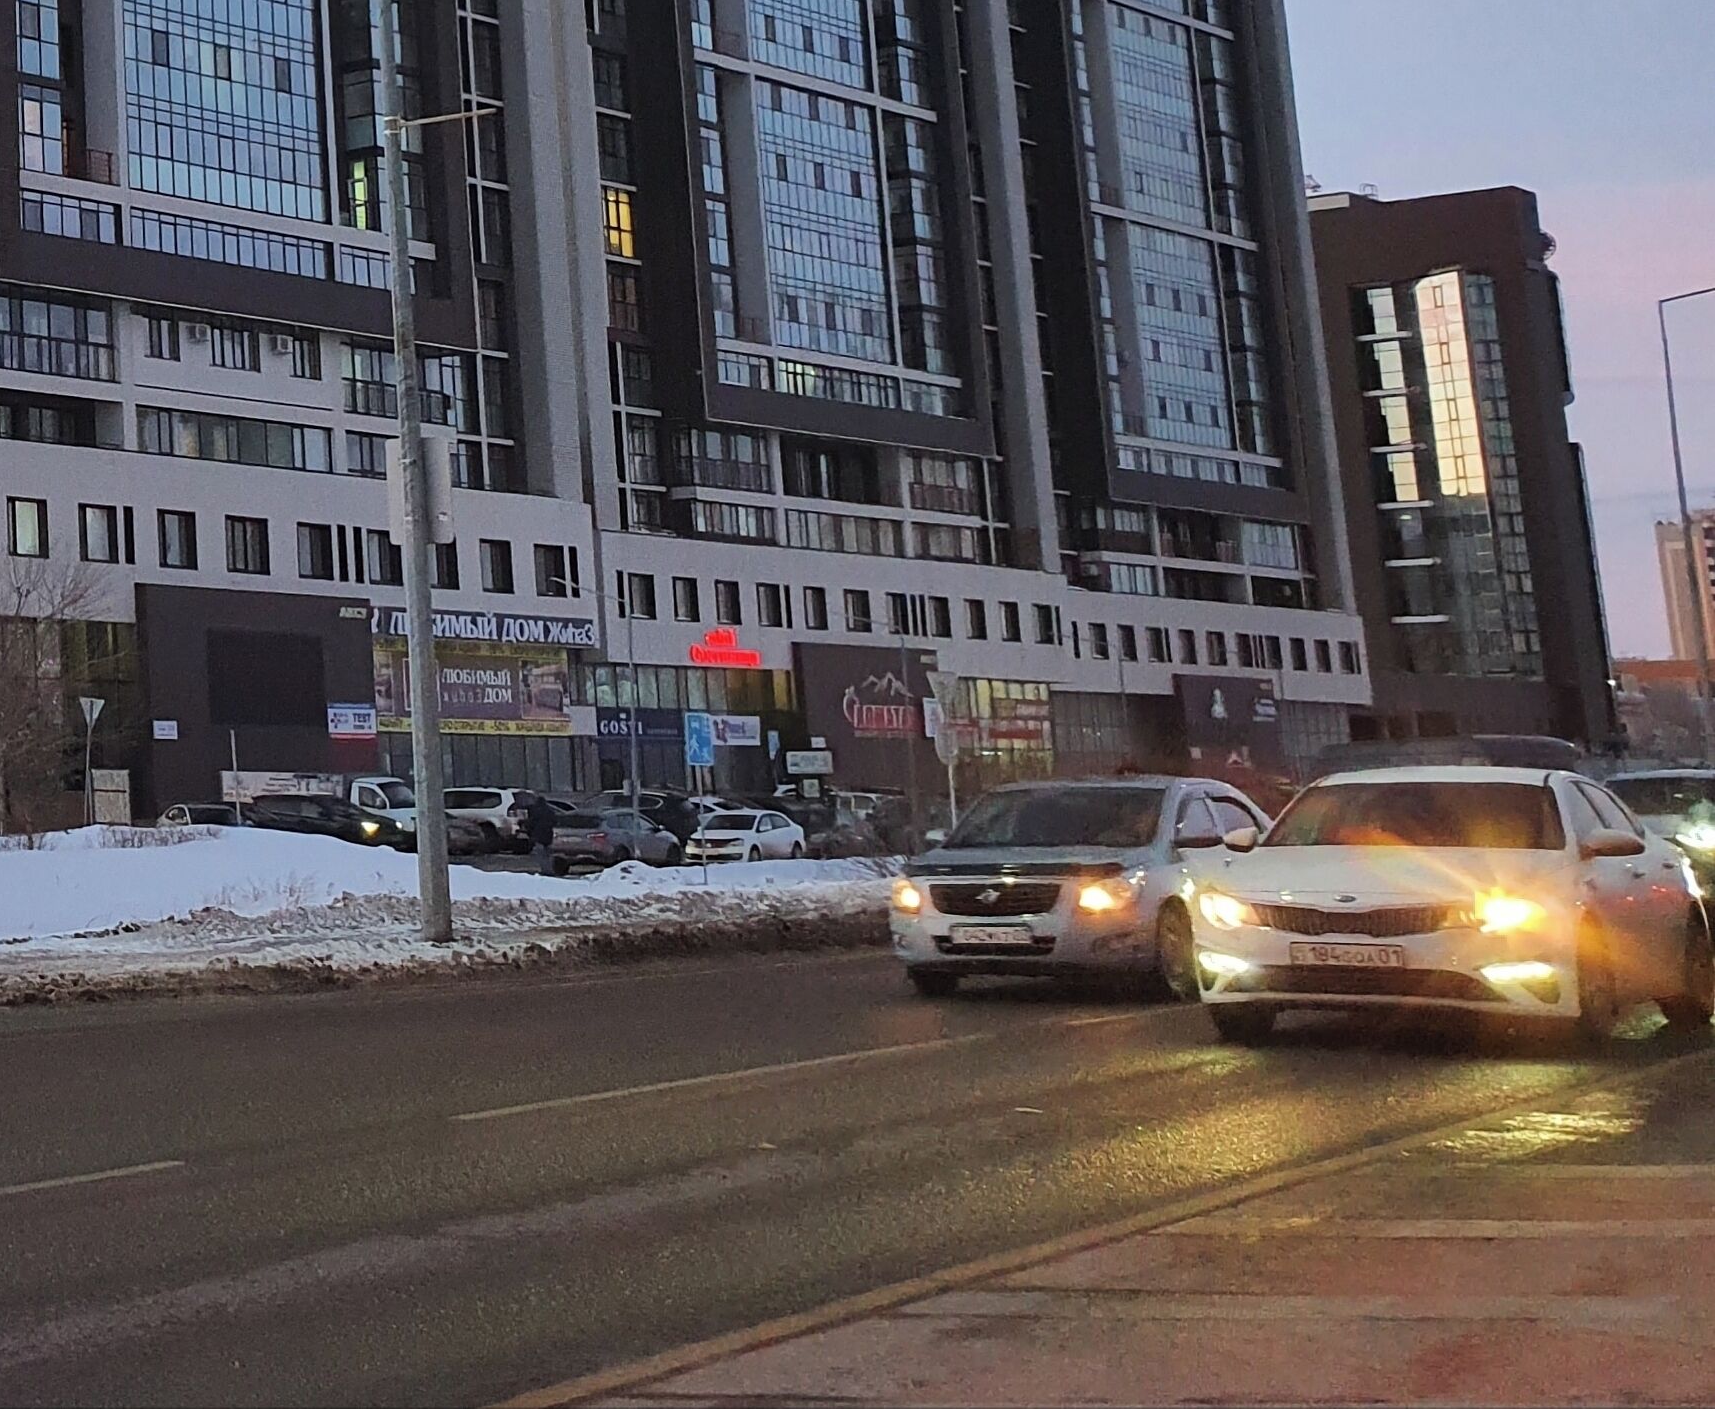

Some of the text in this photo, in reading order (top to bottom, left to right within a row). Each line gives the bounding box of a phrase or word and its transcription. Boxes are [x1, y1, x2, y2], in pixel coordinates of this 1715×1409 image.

[389, 611, 498, 640] ЛИМЫЙ
[502, 618, 544, 643] ДОМ
[442, 668, 511, 686] ЛЮБИМЫЙ
[483, 687, 512, 703] ДОМ
